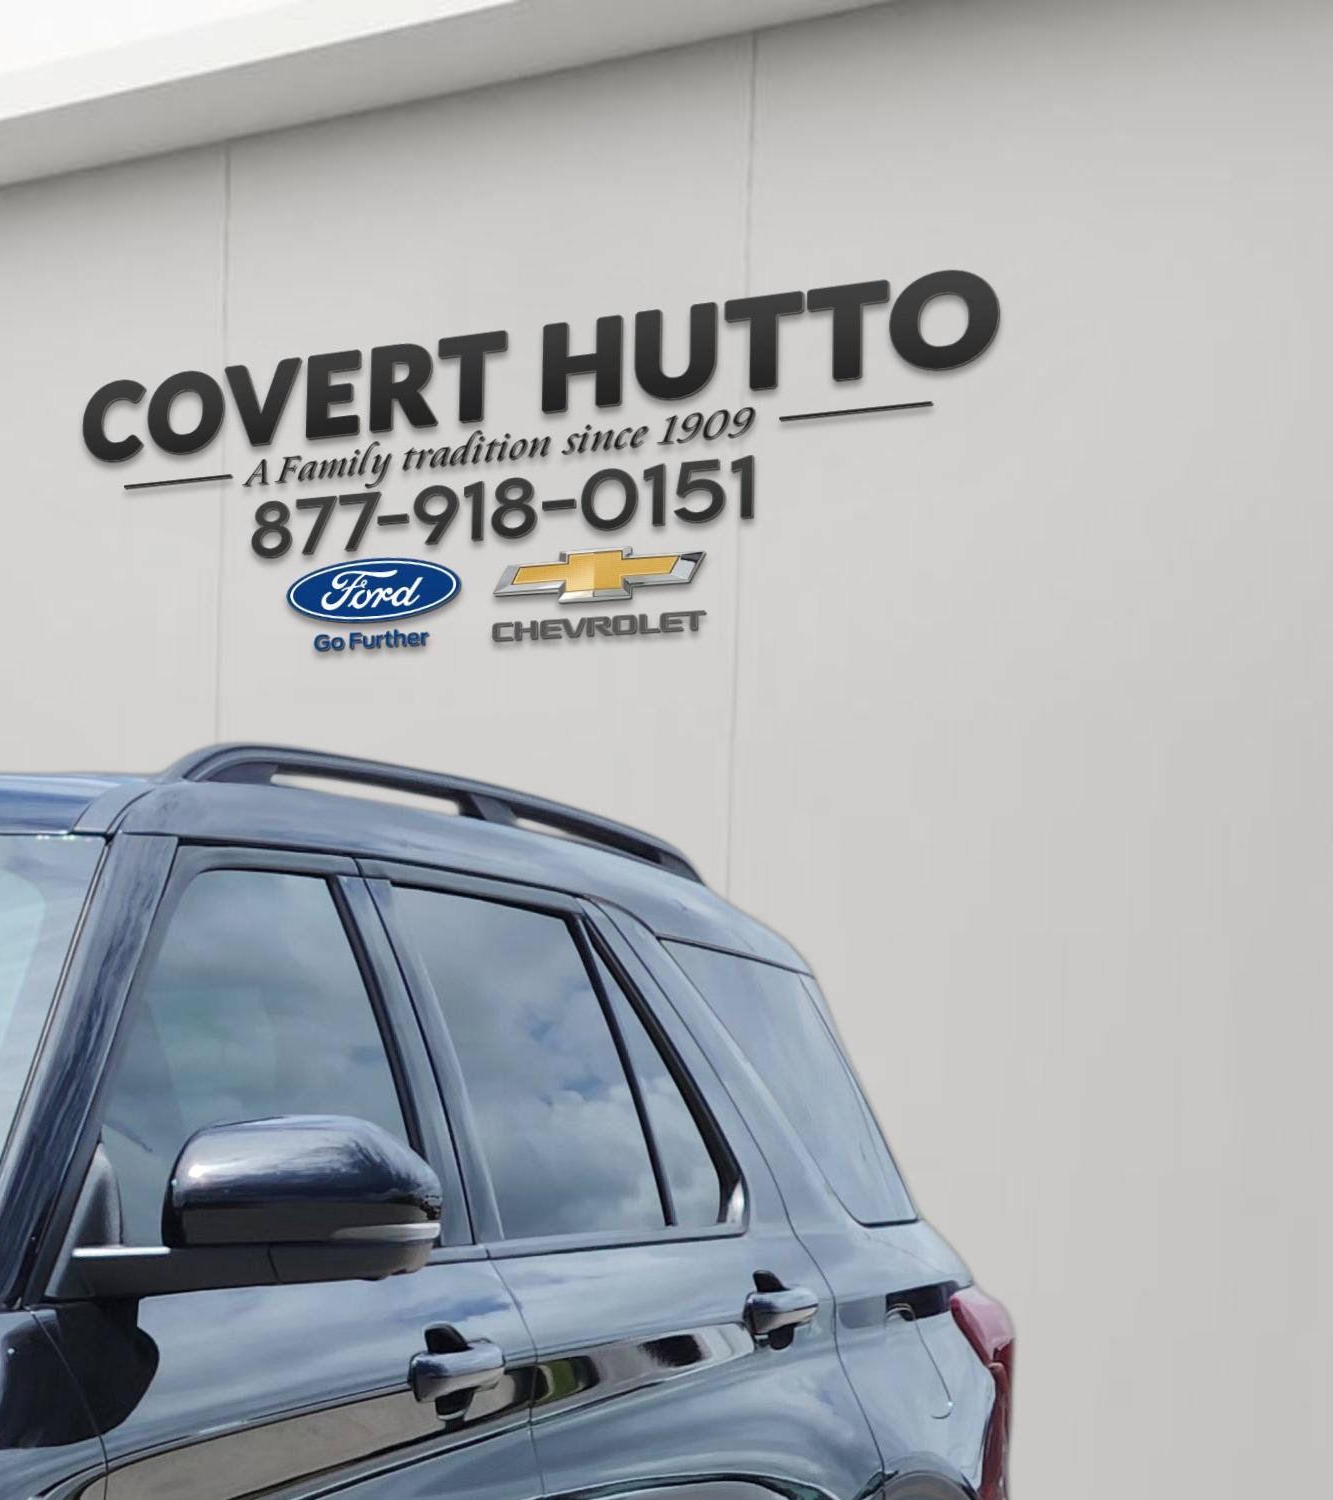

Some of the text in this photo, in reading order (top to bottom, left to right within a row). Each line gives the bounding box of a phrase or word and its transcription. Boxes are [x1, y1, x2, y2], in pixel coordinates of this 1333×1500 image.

[82, 269, 1001, 464] COVERT HUTTO
[242, 406, 756, 489] A Family tradition since 1909
[251, 455, 755, 560] 877-918-0151
[320, 569, 424, 611] Ford
[313, 629, 430, 653] Go Further
[492, 610, 708, 643] CHEVROLET
